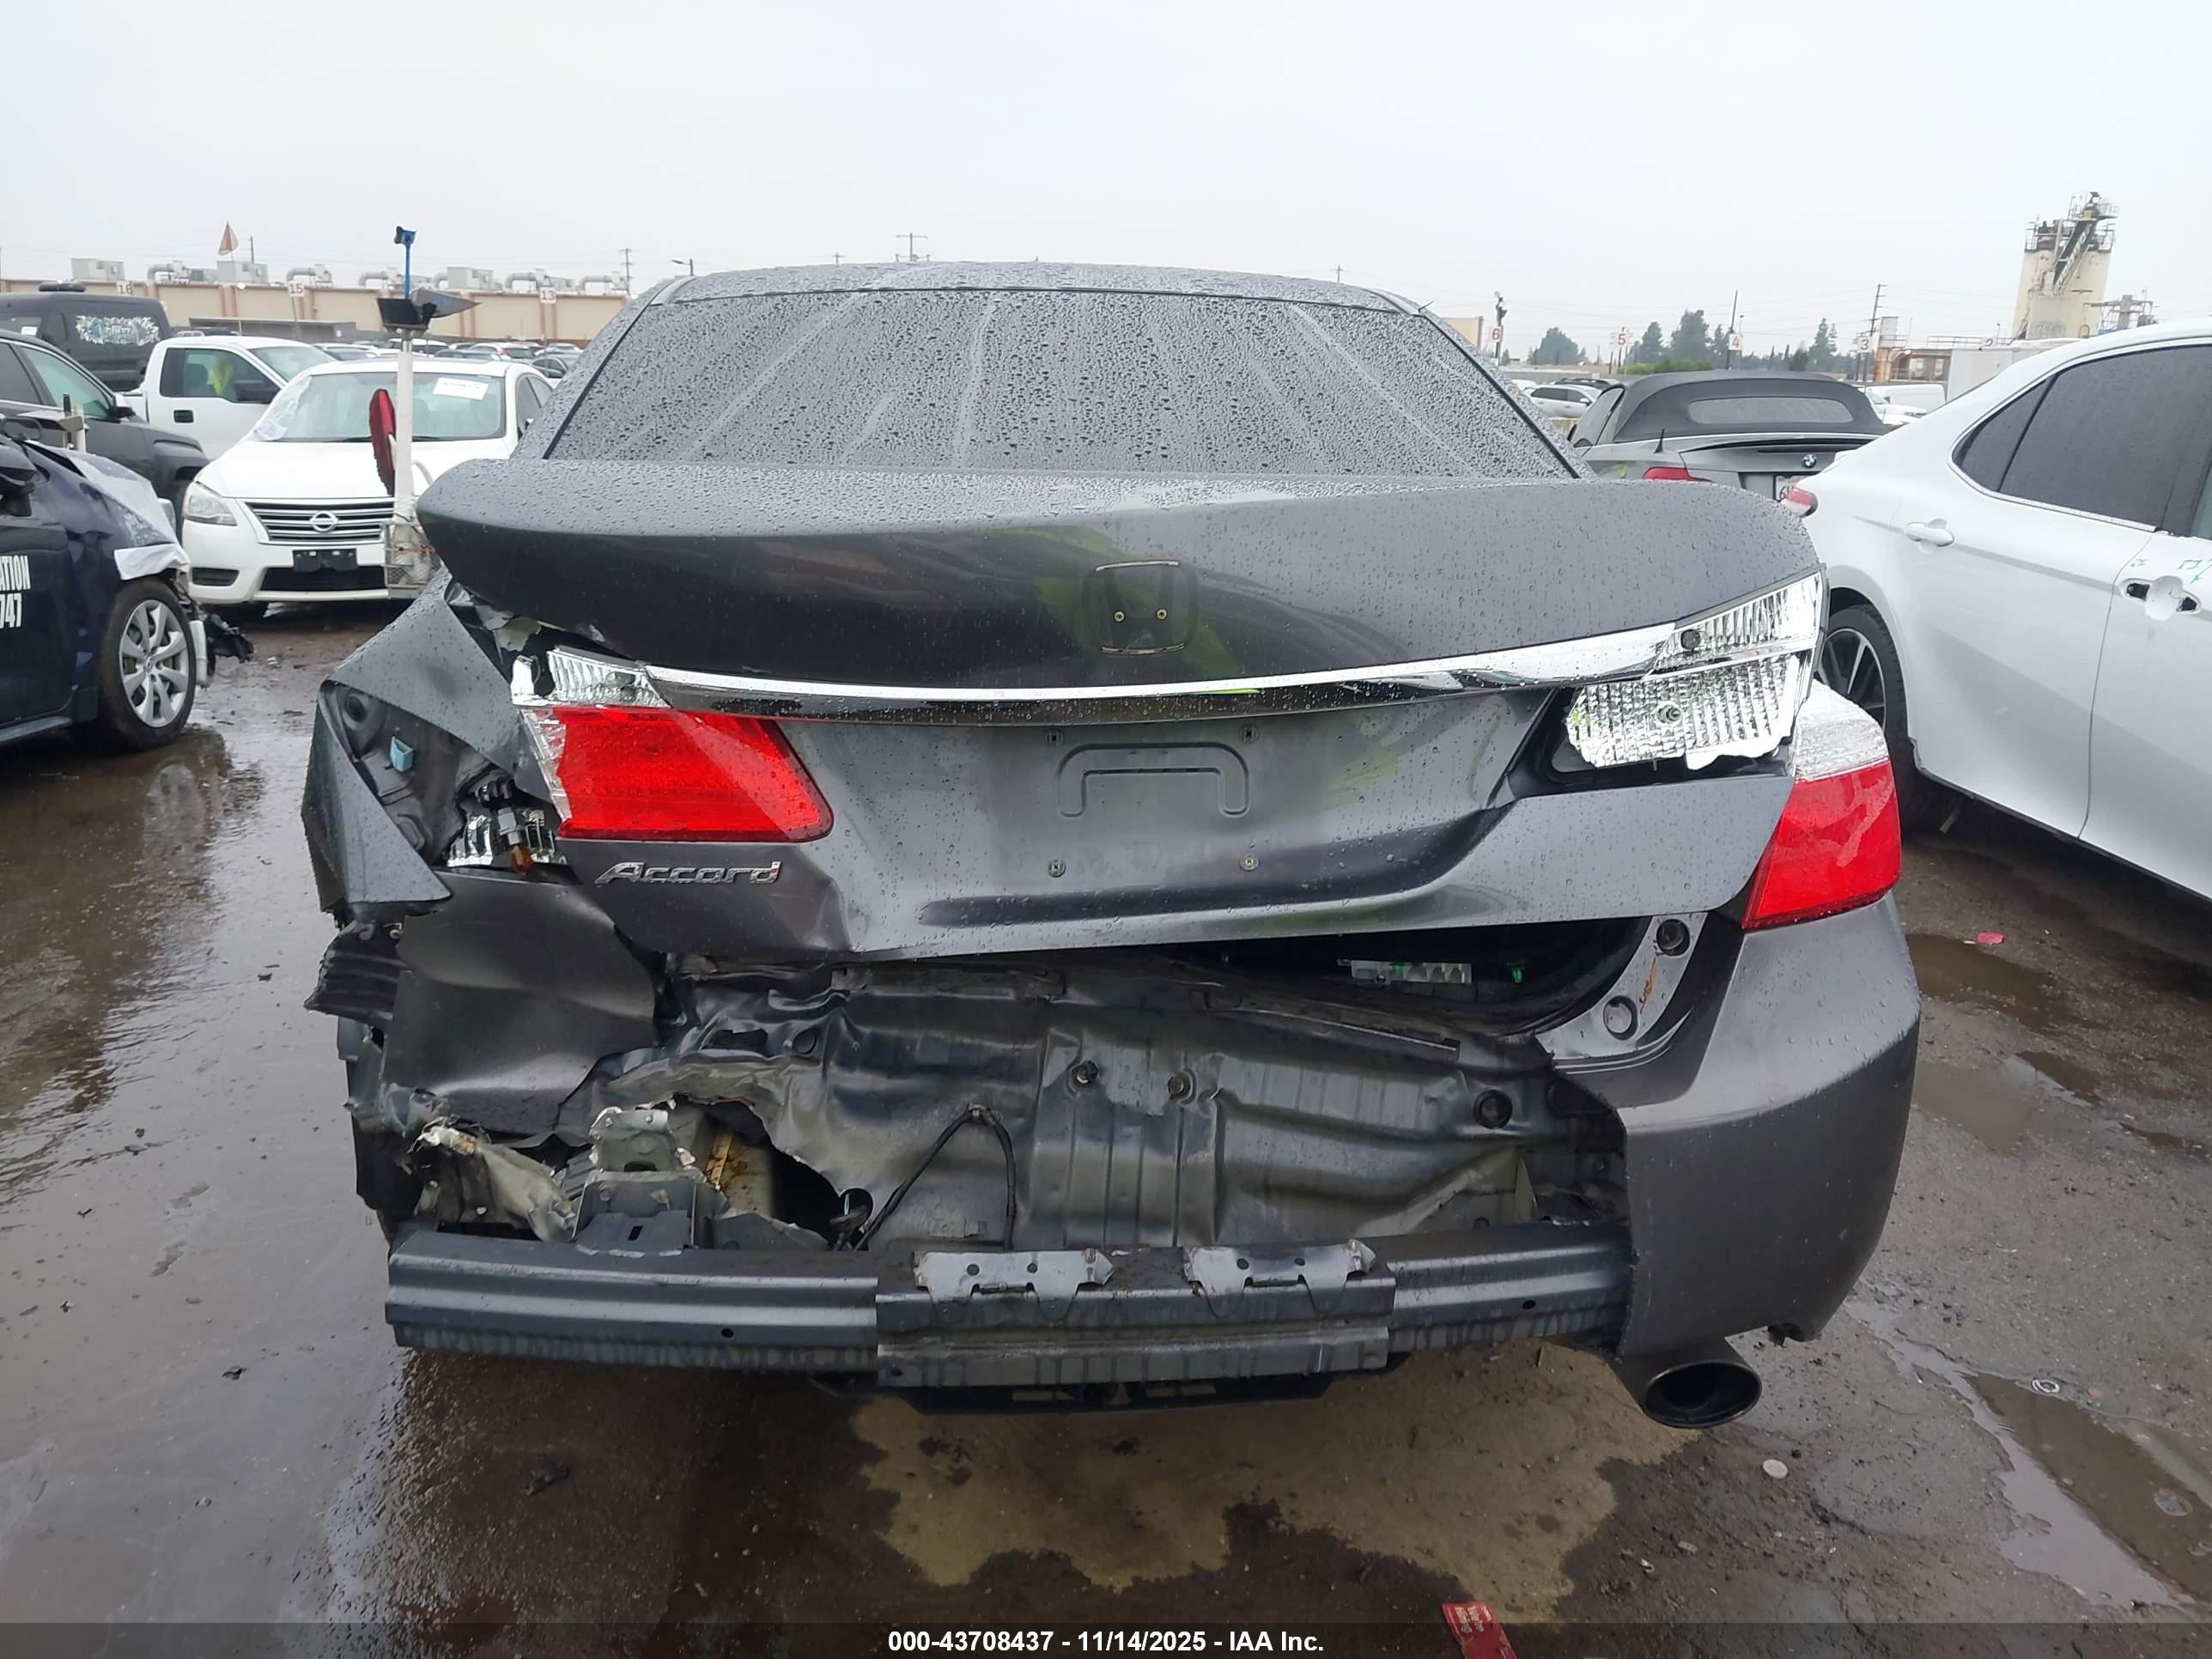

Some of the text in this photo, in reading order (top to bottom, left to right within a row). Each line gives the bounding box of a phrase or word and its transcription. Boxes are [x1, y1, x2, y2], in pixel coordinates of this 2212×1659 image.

[289, 283, 303, 294] 15
[542, 290, 555, 300] 13
[1618, 333, 1626, 345] 5
[1731, 336, 1740, 349] 4
[1861, 339, 1869, 350] 3
[594, 861, 781, 884] Accord
